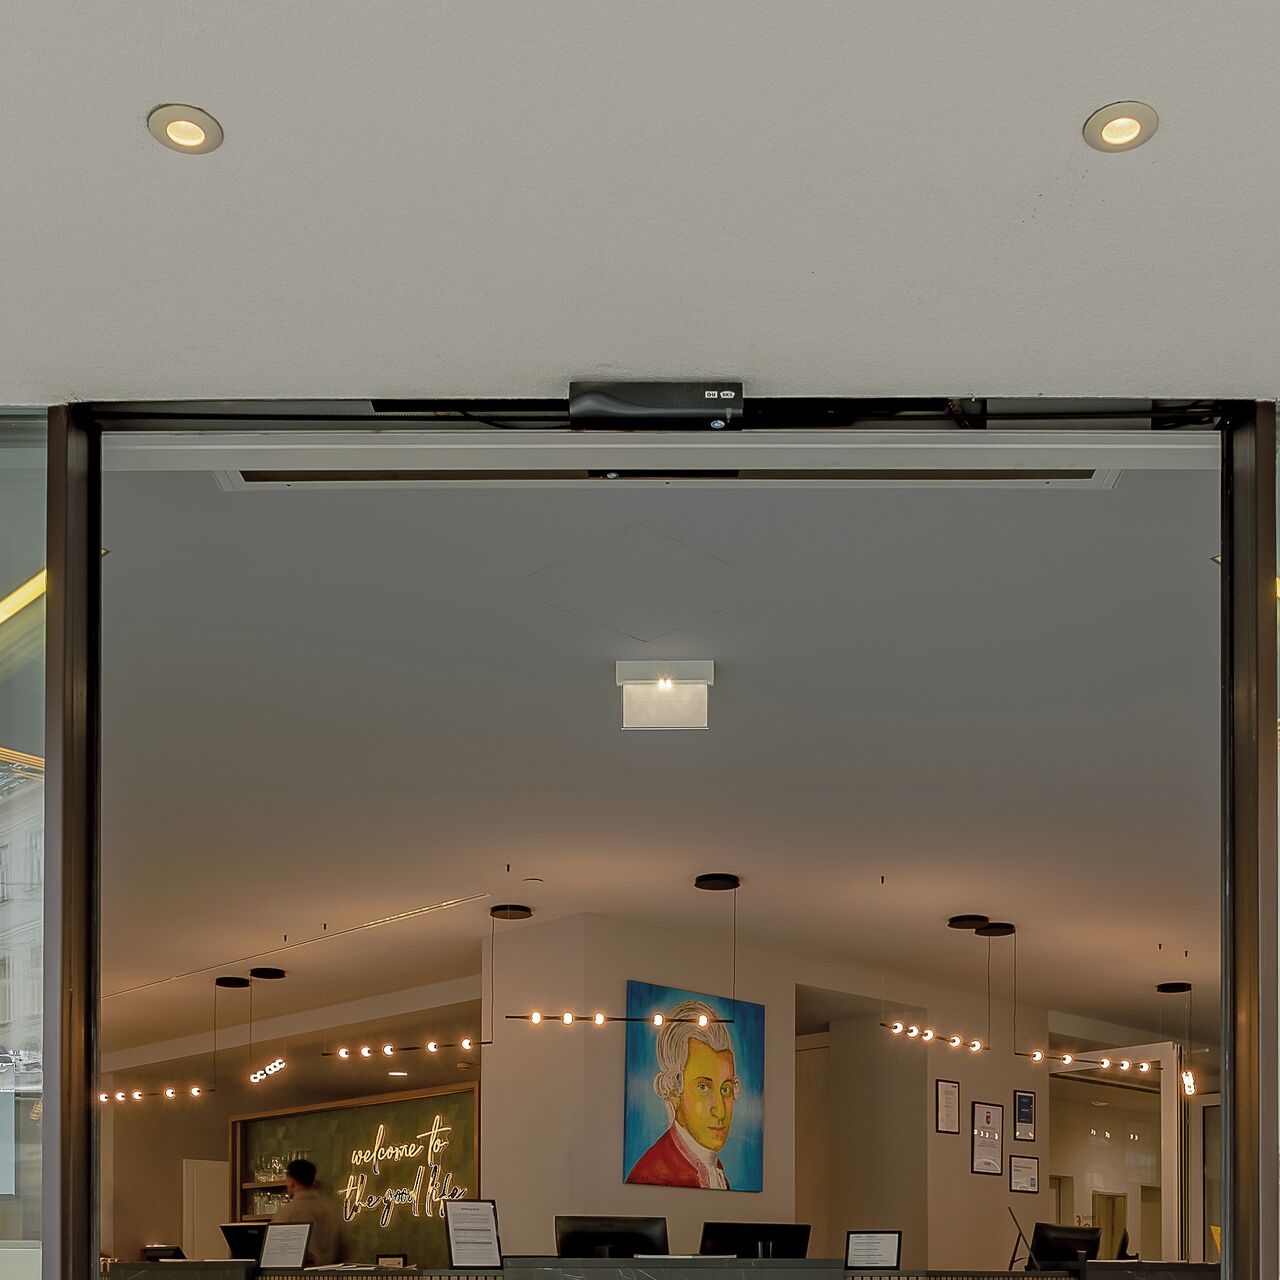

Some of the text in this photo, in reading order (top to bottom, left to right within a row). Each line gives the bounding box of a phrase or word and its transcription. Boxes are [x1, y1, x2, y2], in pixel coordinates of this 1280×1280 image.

[351, 1114, 453, 1175] welcome to
[337, 1163, 468, 1228] the good life
